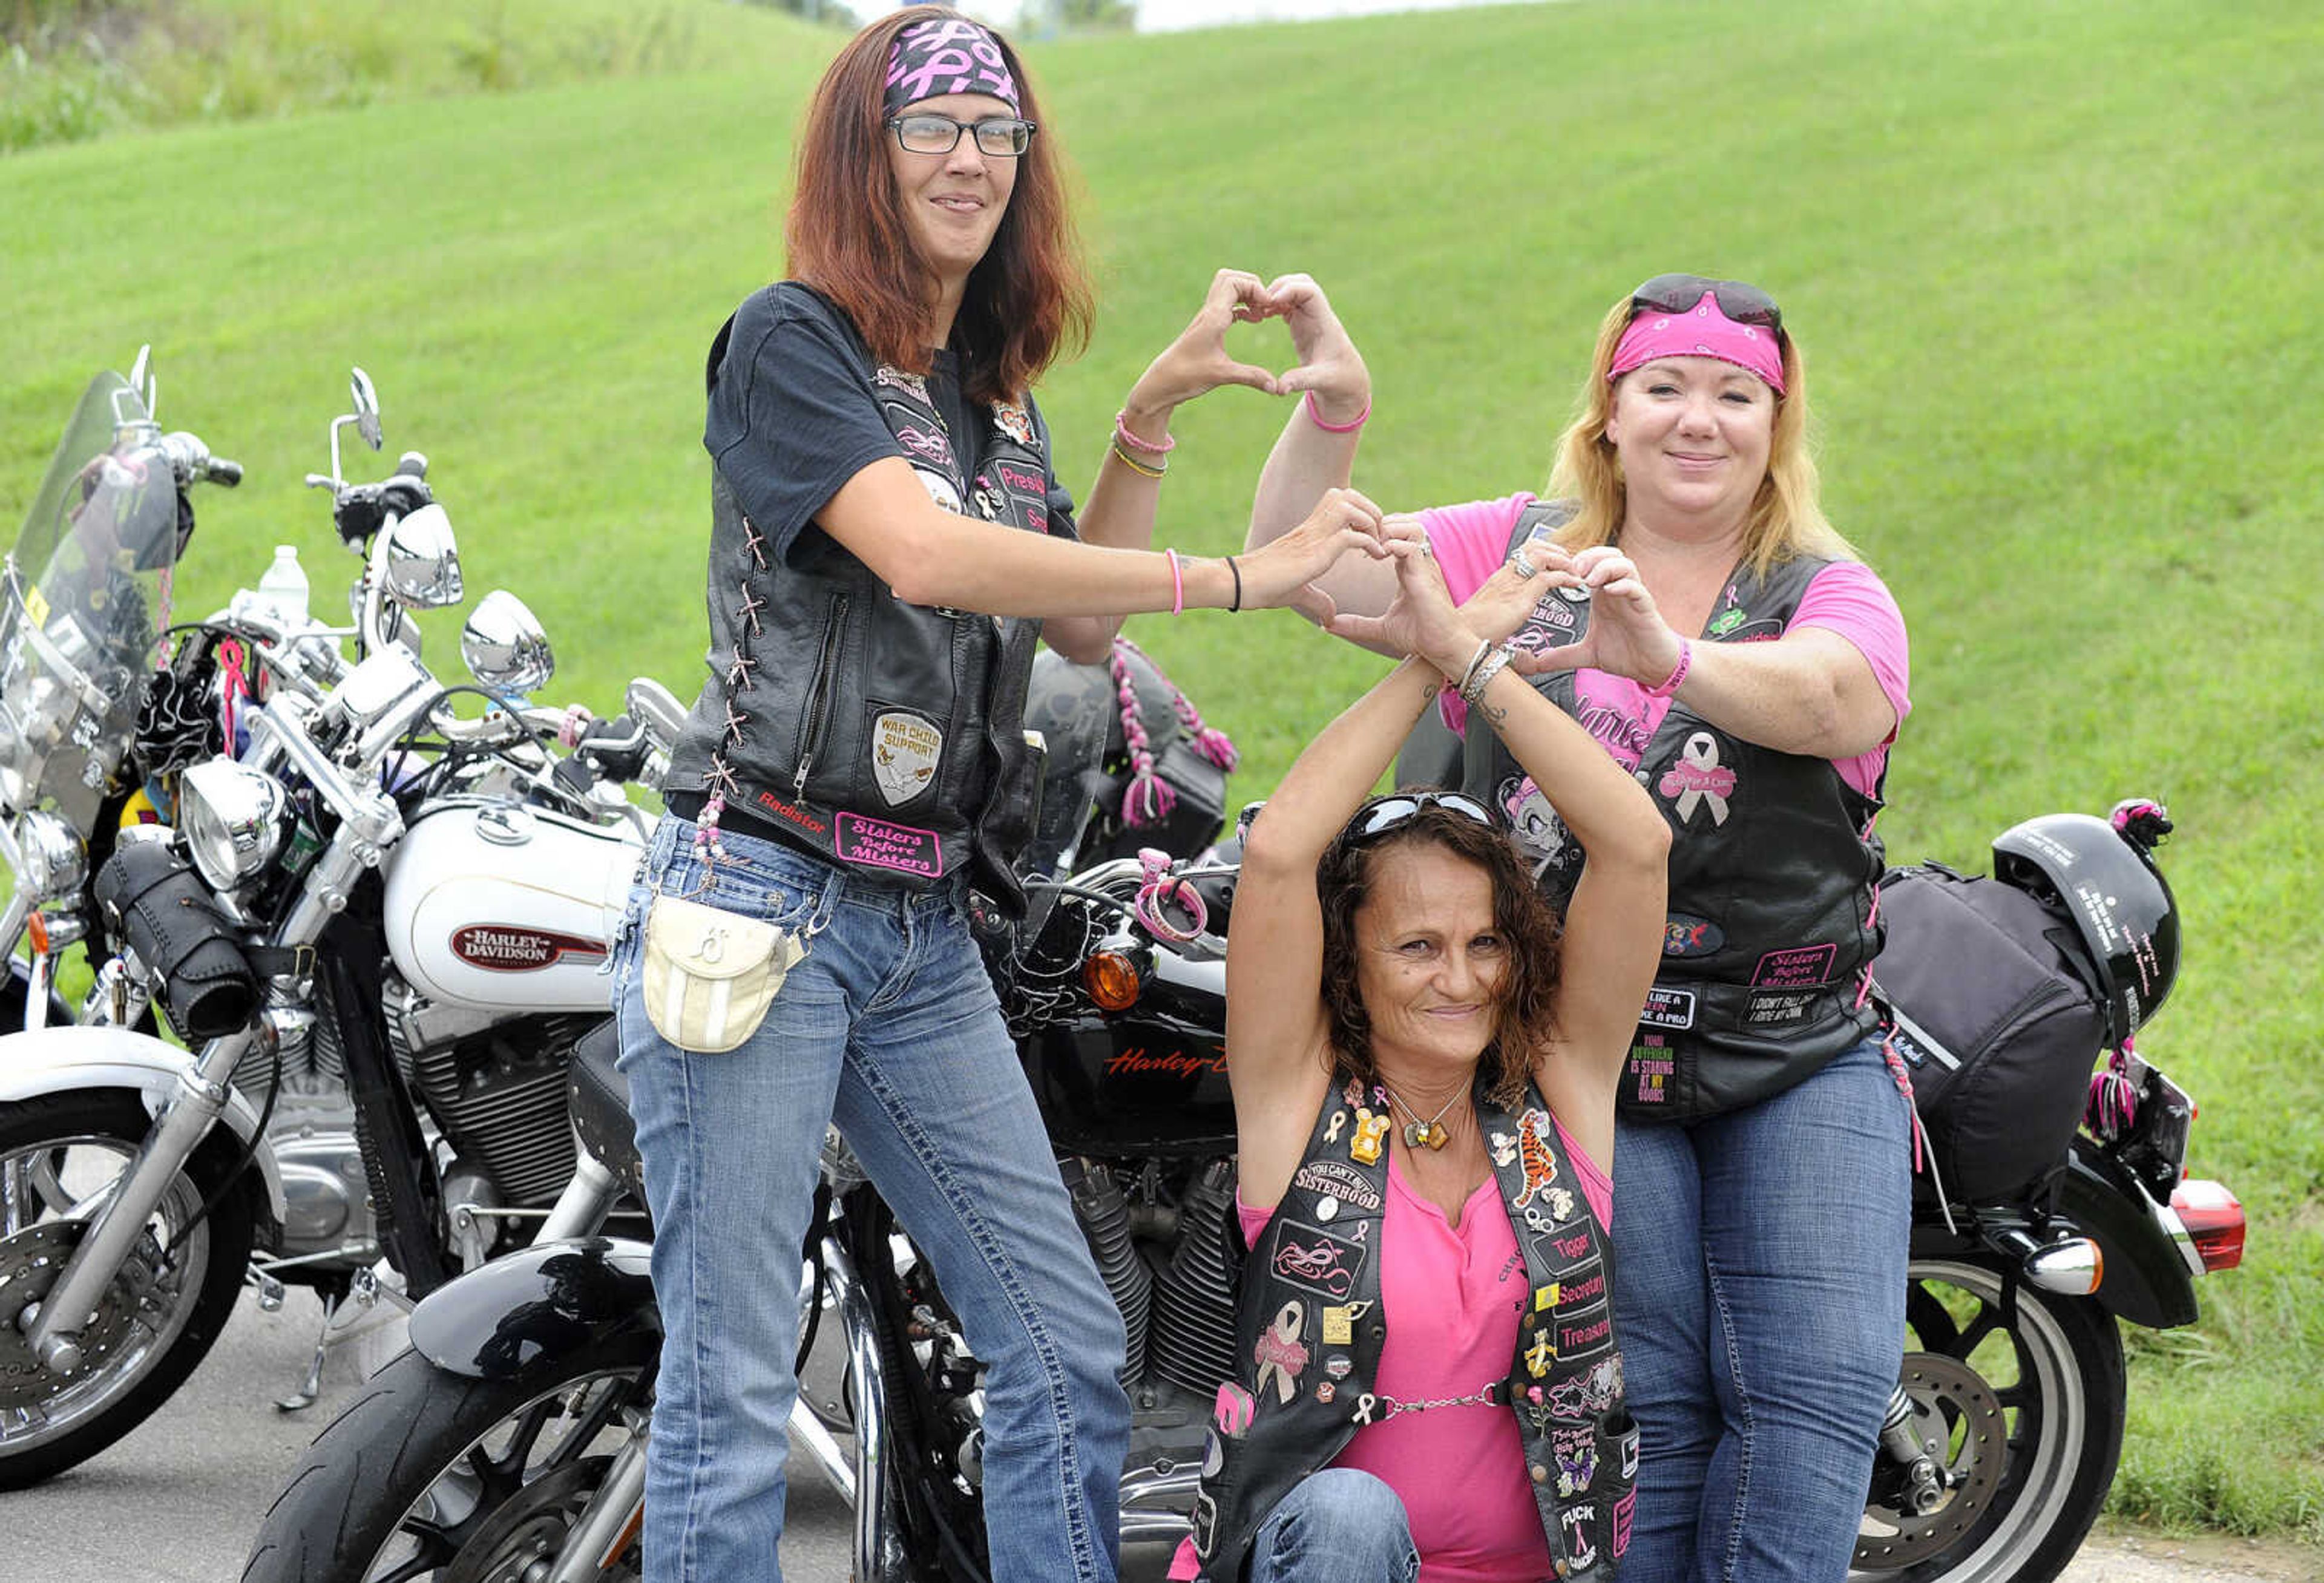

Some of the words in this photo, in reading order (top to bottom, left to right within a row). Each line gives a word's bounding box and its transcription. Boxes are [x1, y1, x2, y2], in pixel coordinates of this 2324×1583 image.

[882, 718, 906, 735] WAR
[910, 727, 939, 746] CHILD
[885, 733, 932, 758] SUPPORT
[757, 791, 826, 834] Radiator
[852, 820, 923, 846] Sisters
[860, 836, 916, 855] Before
[851, 845, 930, 871] Misters
[465, 942, 547, 960] DAVIDSON
[474, 929, 540, 948] HARLEY
[1650, 992, 1672, 1003] LIKE
[1673, 996, 1681, 1005] A
[1655, 1012, 1664, 1021] A
[1666, 1013, 1687, 1024] PRO
[1631, 1060, 1640, 1073] IS
[1641, 1060, 1674, 1075] STARING
[1640, 1075, 1650, 1089] AT
[1296, 1168, 1380, 1210] SISTERHOOD
[1311, 1164, 1328, 1175] YOU
[1352, 1176, 1371, 1193] BUY
[1561, 1505, 1595, 1532] FUCK
[1569, 1545, 1597, 1571] CANCER
